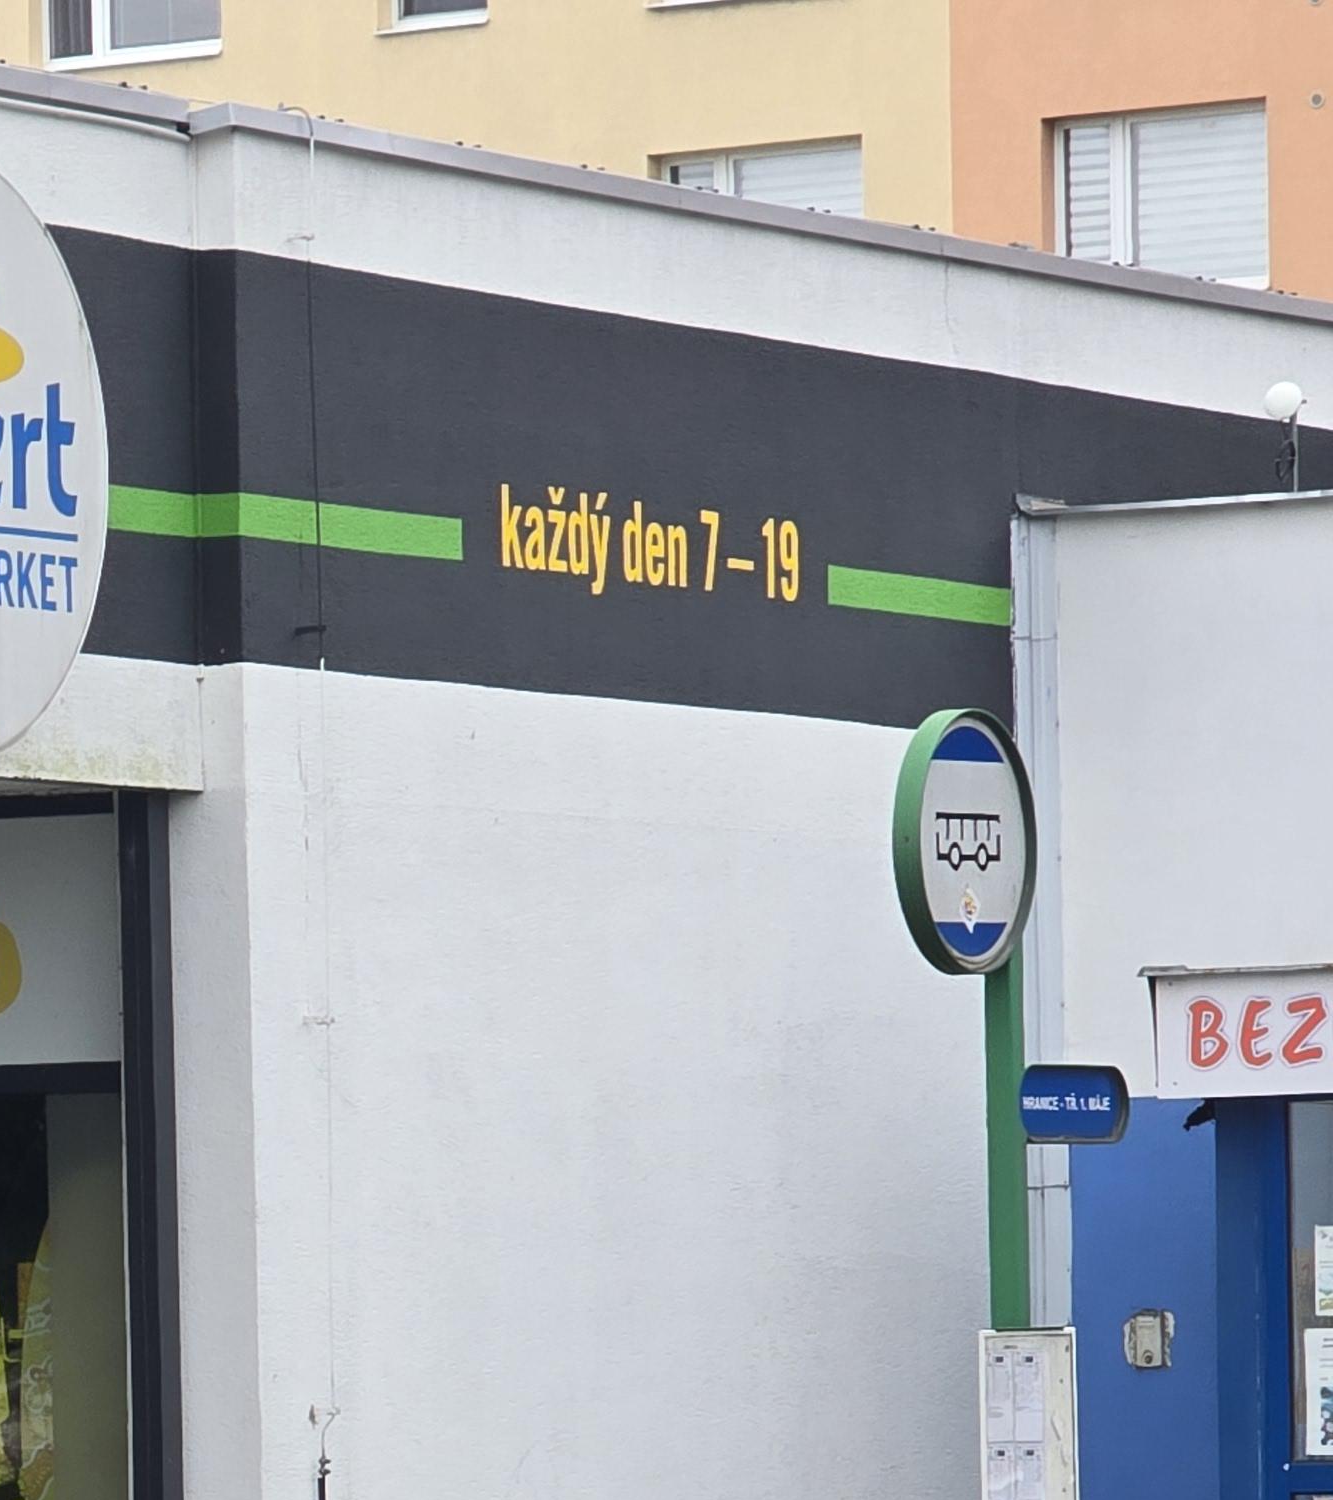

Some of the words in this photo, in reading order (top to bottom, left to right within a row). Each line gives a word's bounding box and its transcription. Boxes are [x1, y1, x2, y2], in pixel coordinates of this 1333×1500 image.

[501, 483, 611, 595] každý
[622, 501, 688, 587] den
[700, 509, 720, 591] 7
[761, 517, 800, 602] 19
[1188, 994, 1328, 1071] BEZ
